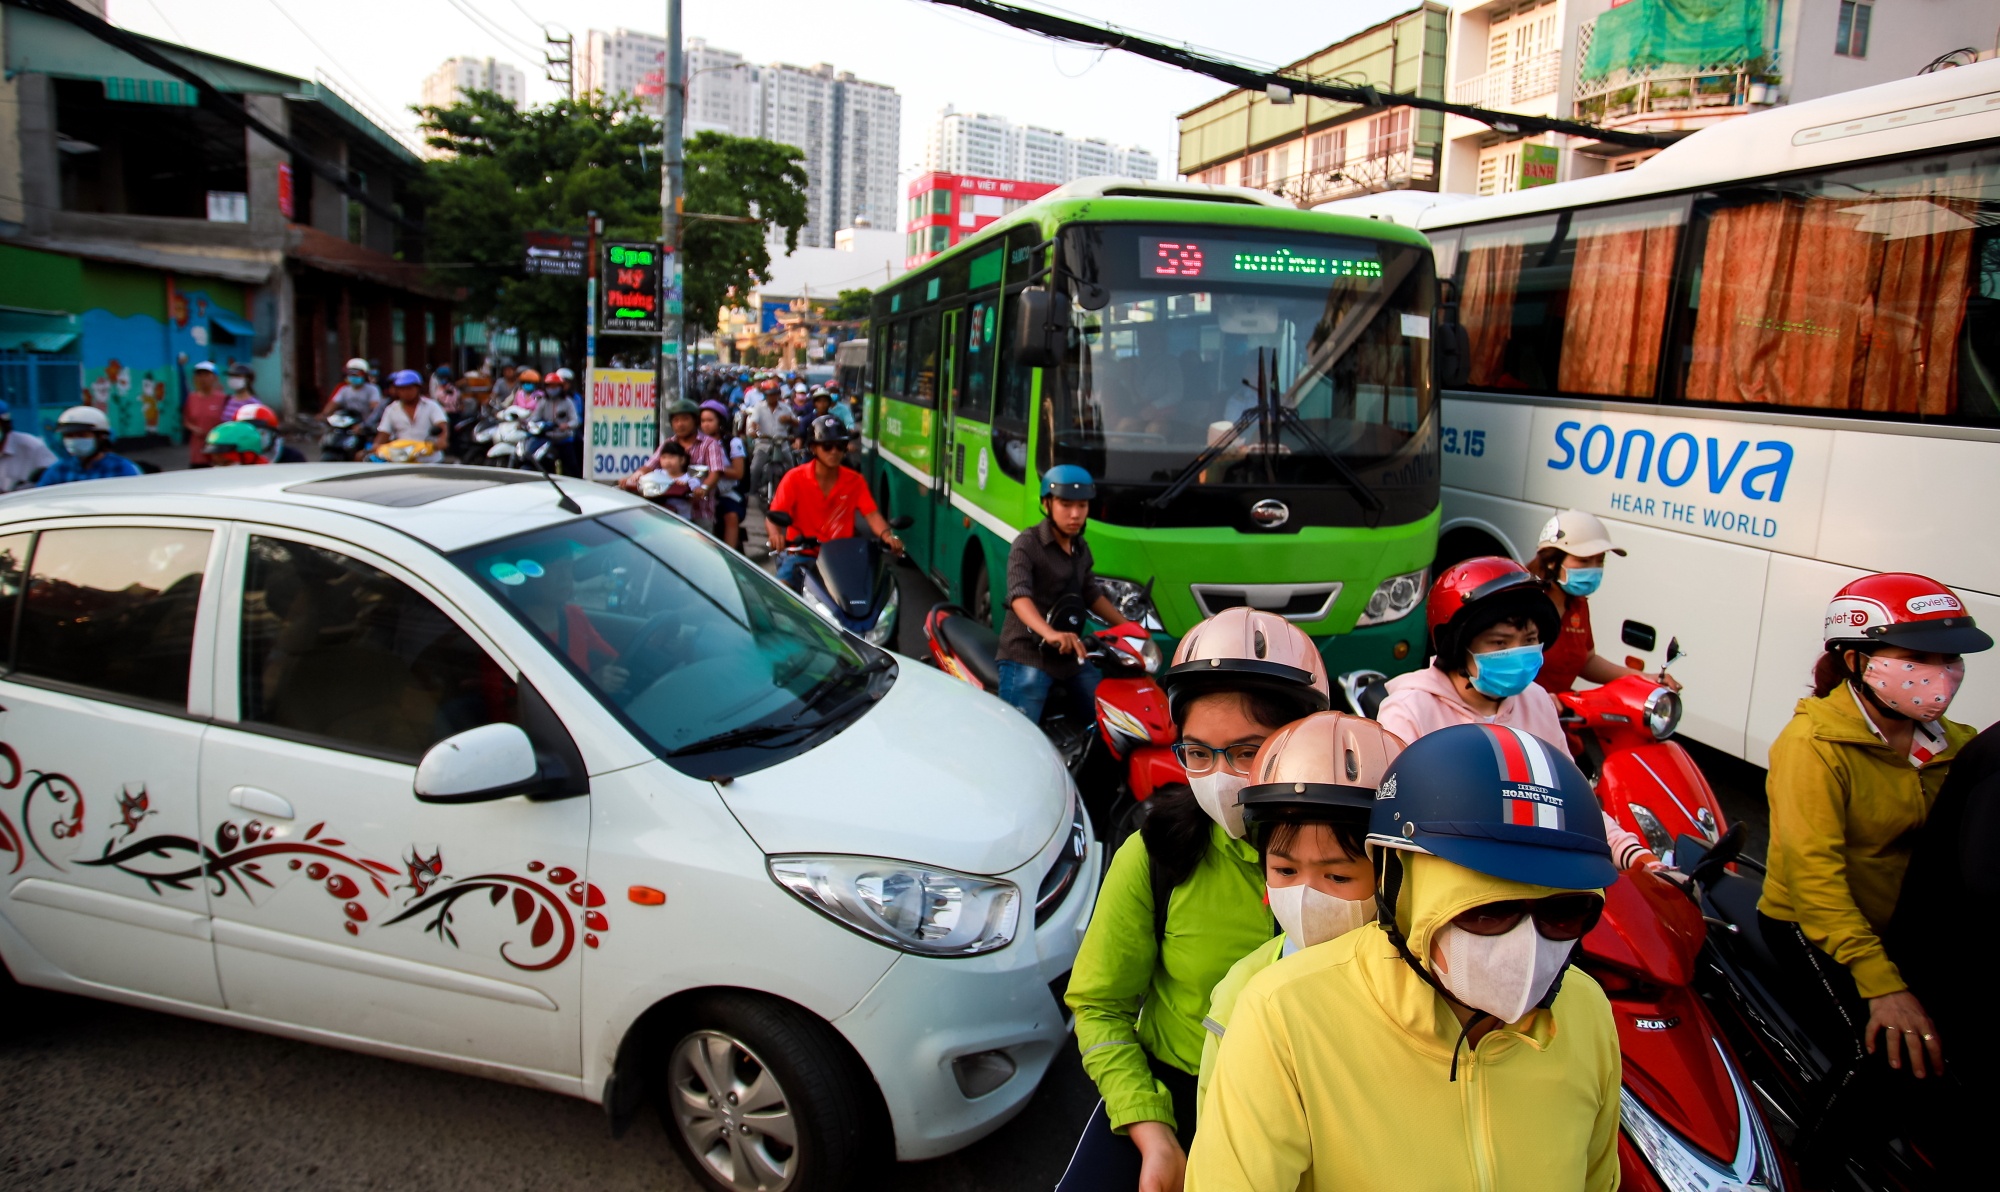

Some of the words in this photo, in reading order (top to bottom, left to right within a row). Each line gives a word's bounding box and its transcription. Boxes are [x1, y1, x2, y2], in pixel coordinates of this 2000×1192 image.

[610, 246, 653, 268] Spa
[1156, 243, 1202, 275] 59
[593, 376, 614, 407] BÚN
[618, 377, 631, 407] BÒ
[592, 415, 608, 446] BÒ
[612, 415, 630, 447] BÍT
[634, 415, 656, 447] TẾT
[1547, 421, 1794, 503] sonova
[1611, 493, 1655, 516] HEAR
[1662, 501, 1695, 523] THE
[1703, 508, 1777, 538] WORLD
[1502, 789, 1541, 801] HOANG
[1541, 794, 1563, 806] VIET
